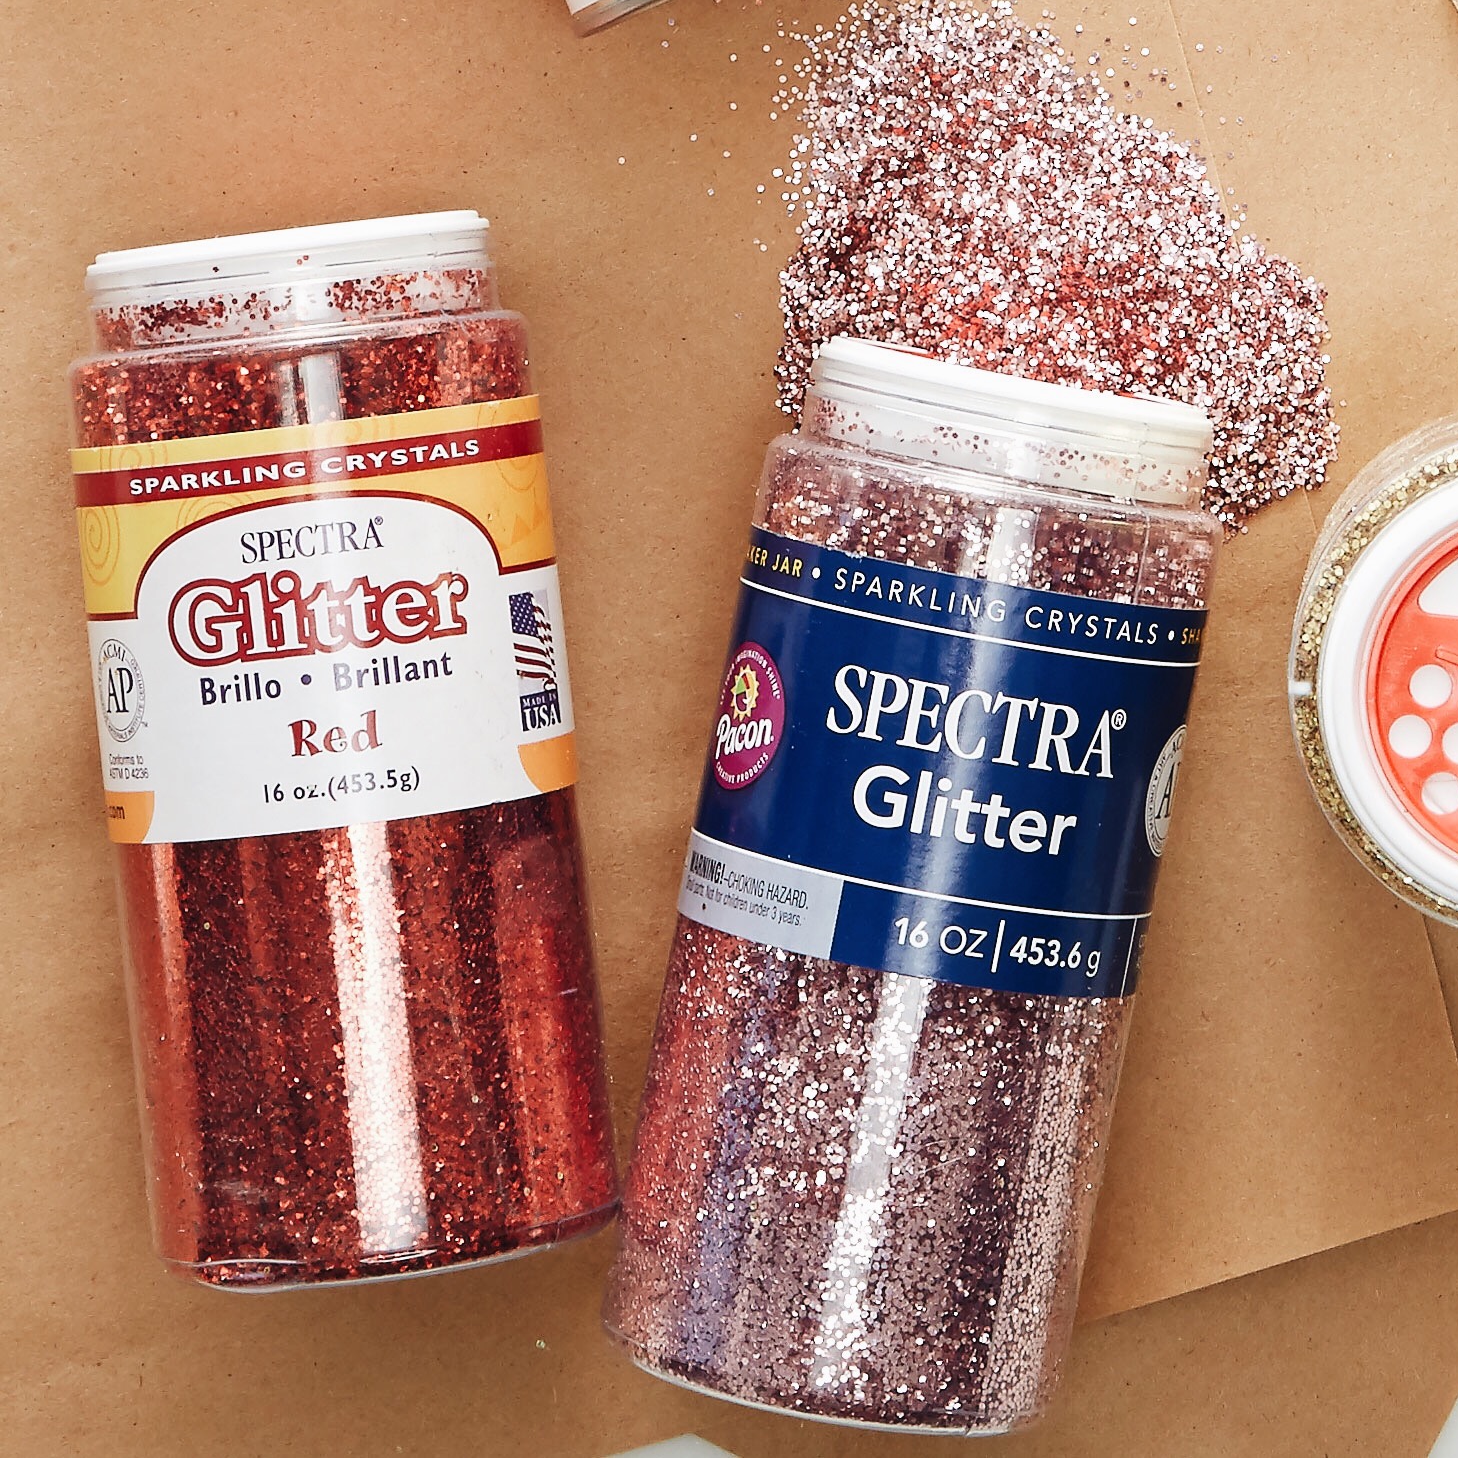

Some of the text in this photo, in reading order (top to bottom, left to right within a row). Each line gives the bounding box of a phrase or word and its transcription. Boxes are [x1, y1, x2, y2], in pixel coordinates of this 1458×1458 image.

[129, 438, 480, 496] SPARKLING CRYSTALS
[746, 545, 768, 567] KER
[772, 554, 803, 577] JAR
[833, 566, 1007, 624] SPARKLING
[1025, 605, 1159, 645] CRYSTALS
[168, 570, 470, 667] Glitter
[107, 668, 134, 713] AP
[199, 651, 454, 707] Brillo Brillant
[522, 696, 545, 708] MADE
[523, 704, 559, 731] USA
[288, 711, 383, 758] Red
[137, 754, 143, 764] to
[736, 752, 769, 784] PRODUCTS
[263, 782, 285, 803] 16
[853, 765, 1077, 856] Glitter
[749, 901, 771, 918] under
[771, 907, 777, 920] 3
[766, 882, 809, 910] HAZARD.
[894, 916, 929, 949] 16
[939, 924, 985, 960] OZ
[1009, 934, 1082, 971] 453.6
[1086, 947, 1101, 978] g
